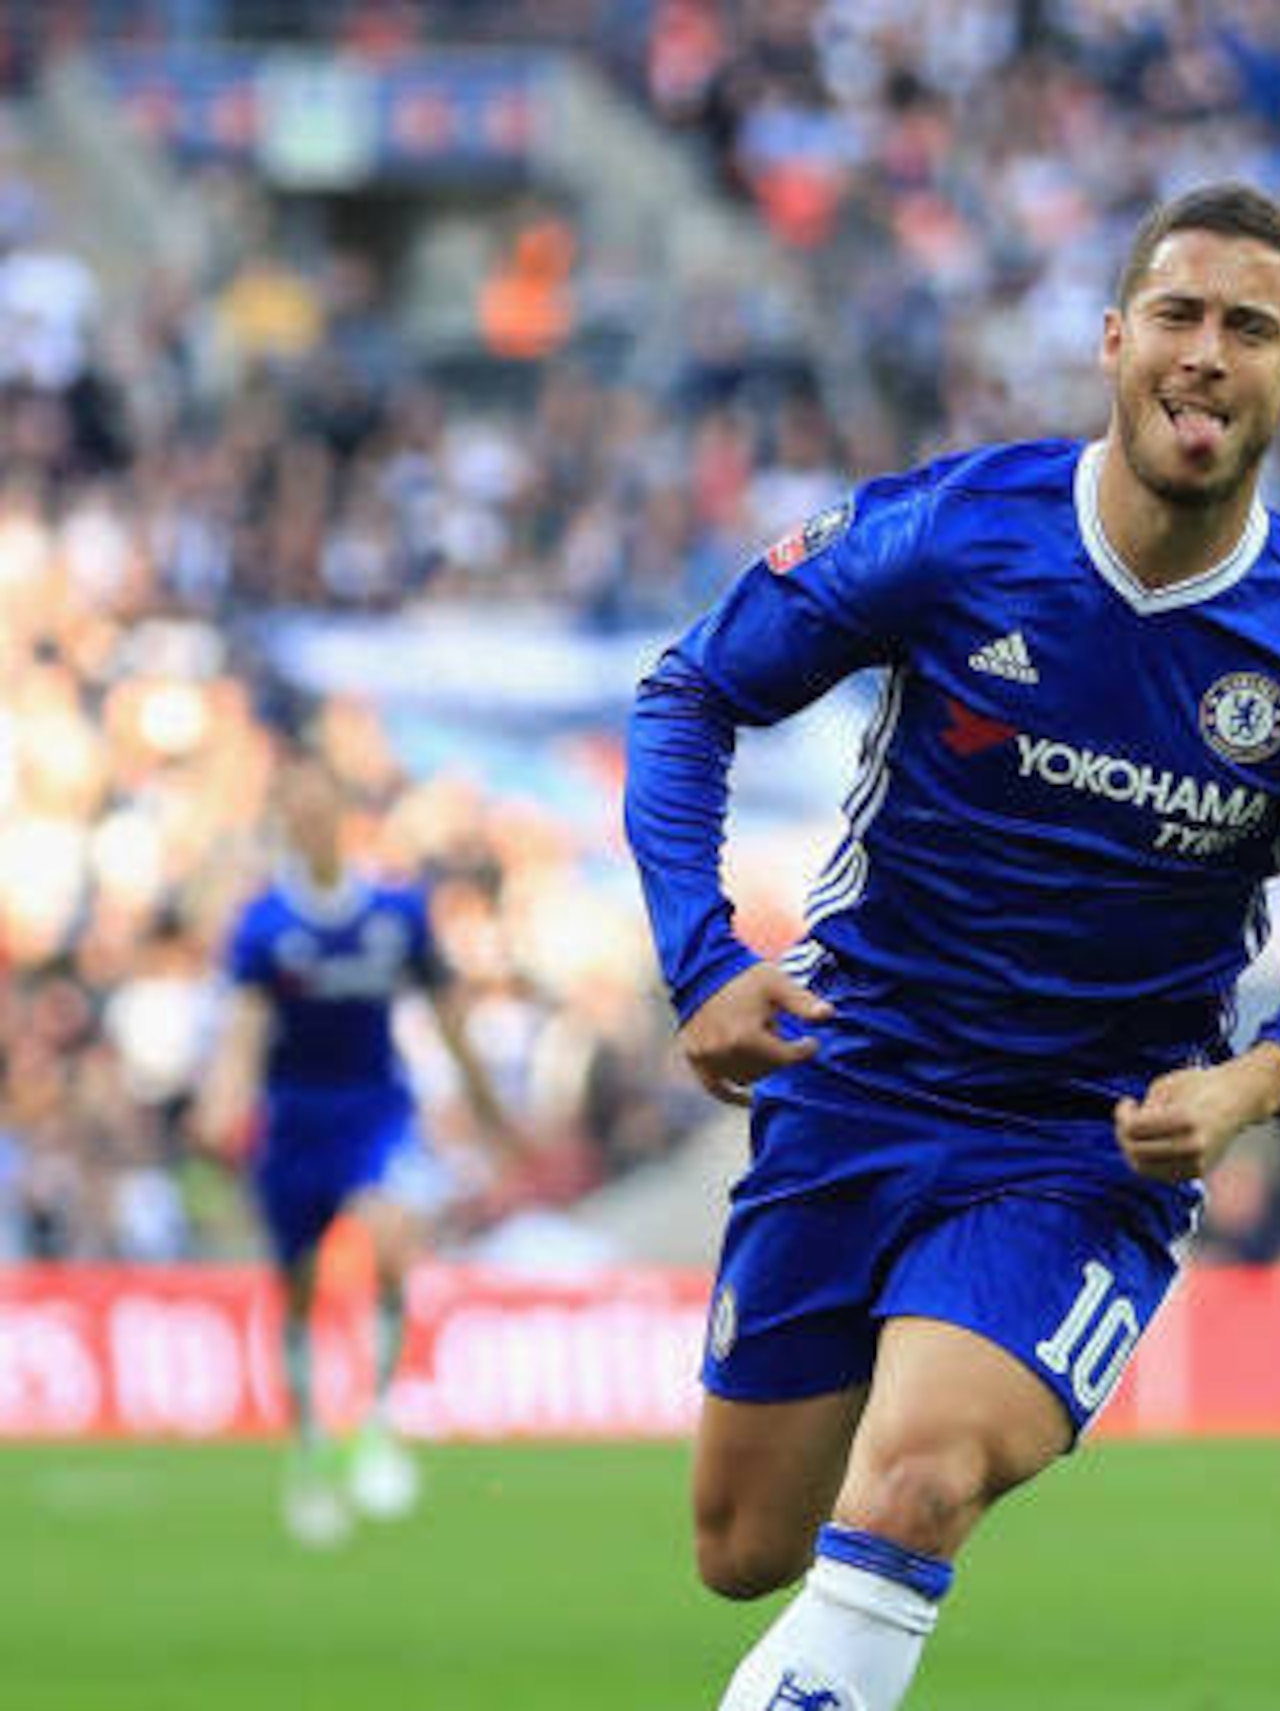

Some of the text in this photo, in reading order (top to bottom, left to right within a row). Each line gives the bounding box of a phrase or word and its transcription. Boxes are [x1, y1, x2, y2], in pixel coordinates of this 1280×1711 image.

[1014, 733, 1268, 828] YOKOHAMA
[1153, 820, 1240, 856] TYR
[1034, 1259, 1141, 1413] 10
